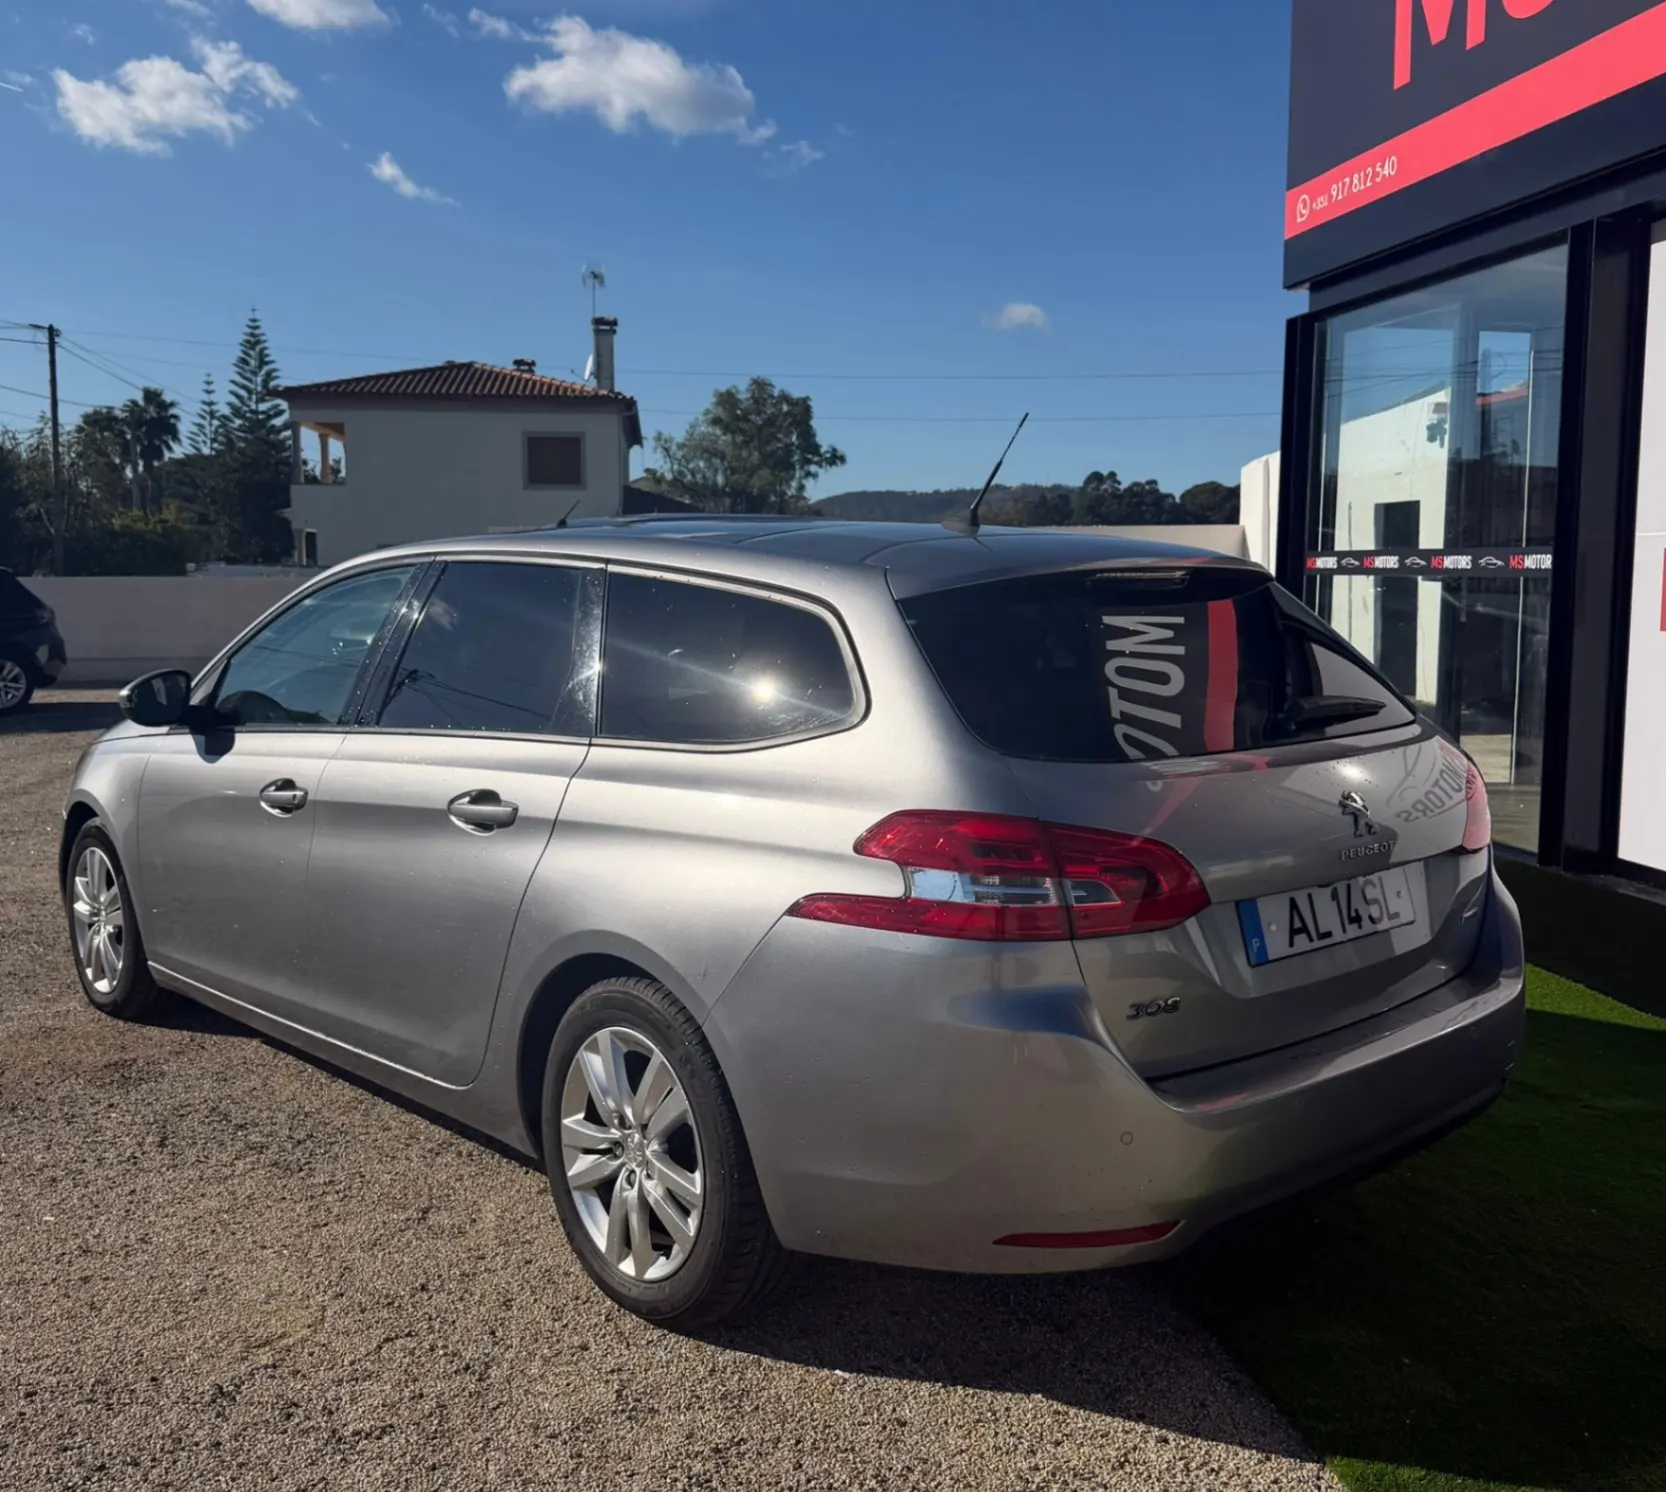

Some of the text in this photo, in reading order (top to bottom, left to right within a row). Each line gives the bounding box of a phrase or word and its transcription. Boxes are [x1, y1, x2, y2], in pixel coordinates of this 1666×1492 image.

[1331, 177, 1350, 202] 917
[1352, 166, 1372, 192] 812
[1376, 156, 1397, 182] 540
[1341, 840, 1396, 861] PEUGEOT
[1126, 996, 1181, 1020] 308
